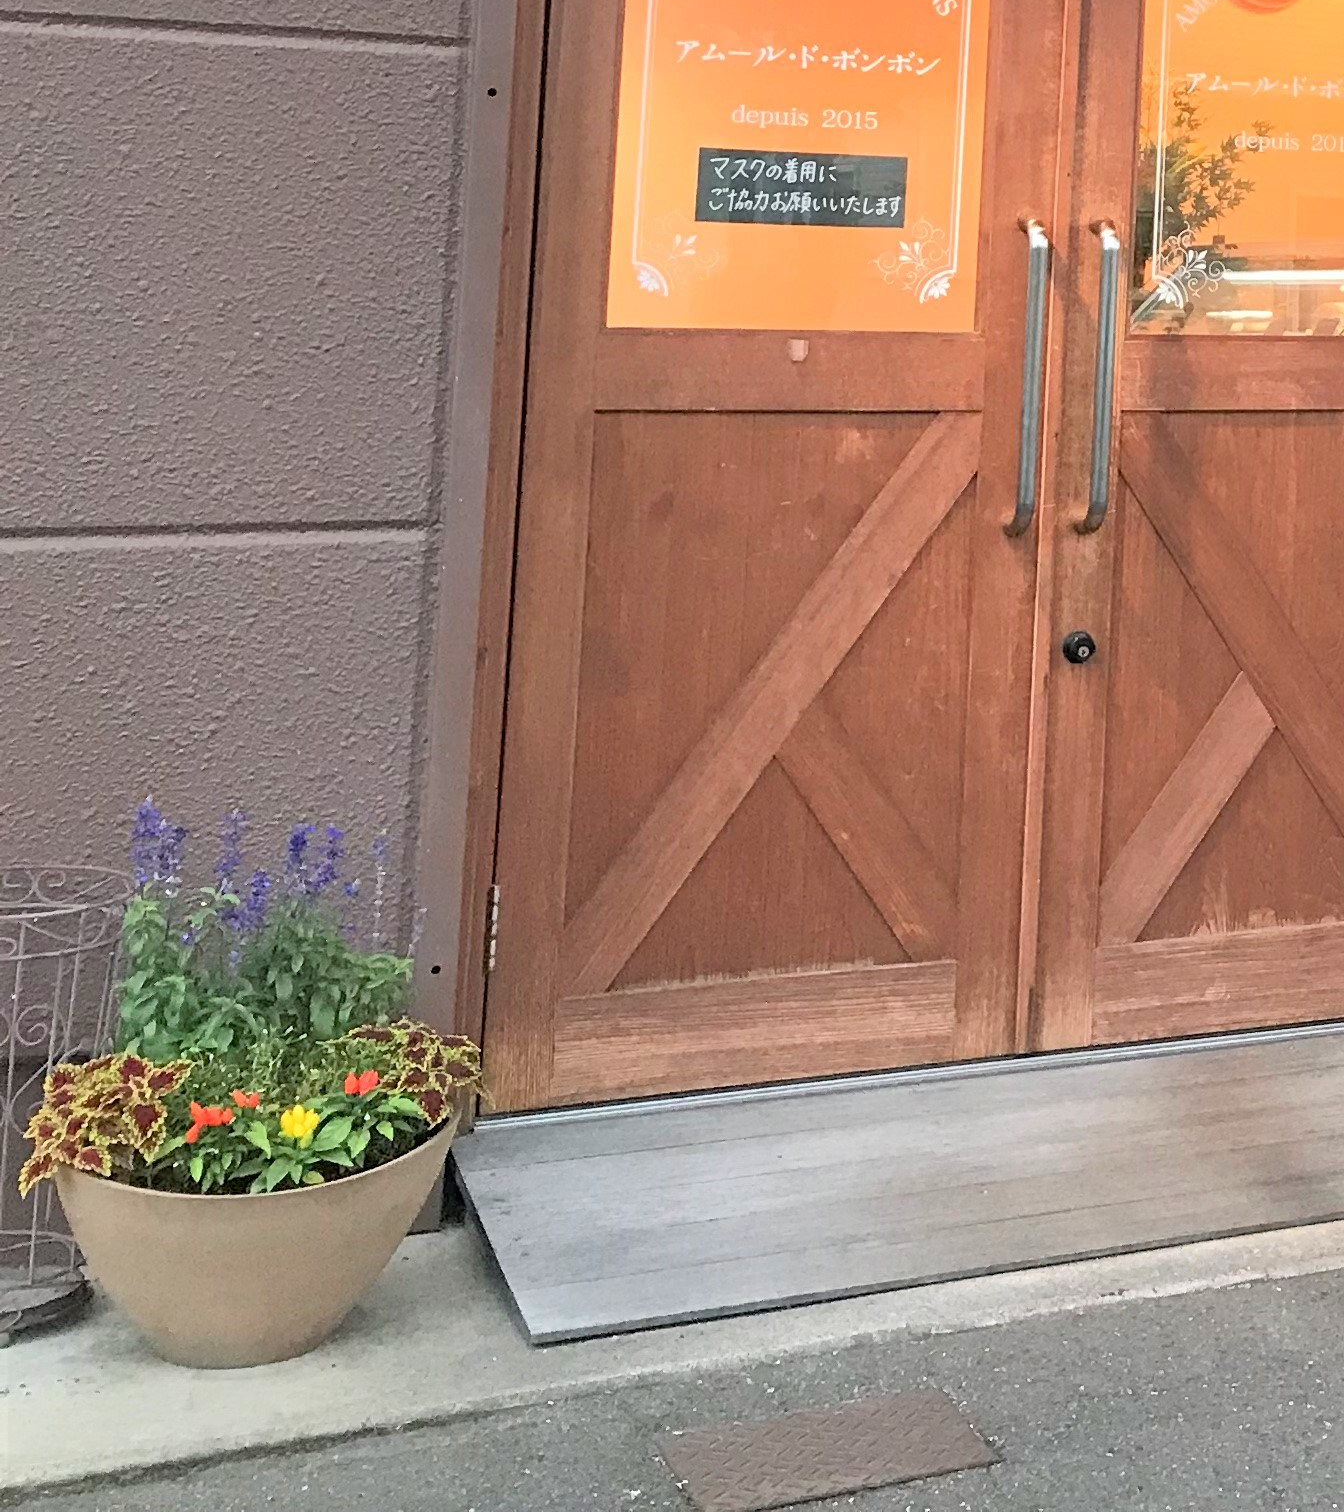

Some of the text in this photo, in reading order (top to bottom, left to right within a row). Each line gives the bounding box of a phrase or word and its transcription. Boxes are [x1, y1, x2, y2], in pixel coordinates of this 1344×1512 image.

[675, 40, 942, 76] アムール・ド・ボンボン
[731, 104, 879, 130] depuis 2015
[1234, 130, 1300, 153] depuis
[709, 156, 838, 184] マスクの着用に
[708, 186, 903, 218] ご協力お願いいたします
